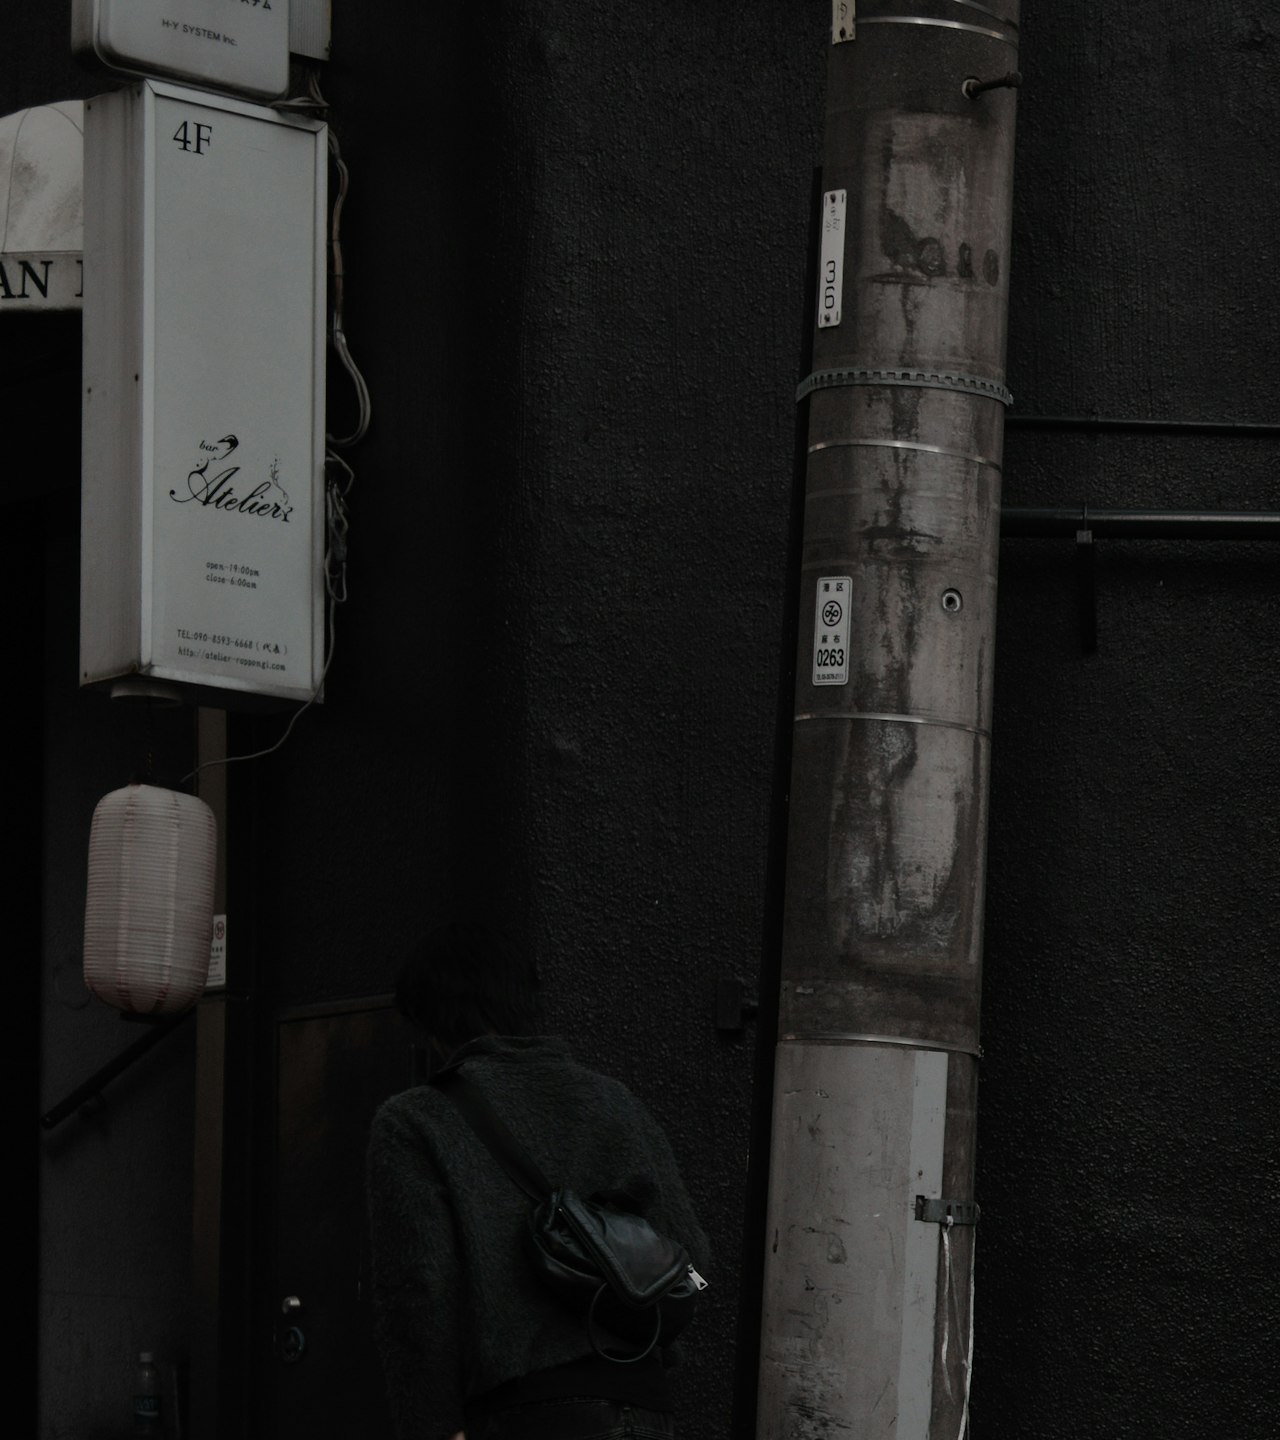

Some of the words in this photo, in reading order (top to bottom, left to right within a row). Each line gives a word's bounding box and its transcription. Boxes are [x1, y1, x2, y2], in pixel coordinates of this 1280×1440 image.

[162, 19, 179, 30] H-Y
[182, 24, 220, 41] SYSTEM
[223, 34, 238, 46] Inc.
[173, 121, 212, 155] 4F
[200, 440, 218, 452] bar
[170, 466, 282, 518] Atelier
[817, 649, 844, 667] 0263
